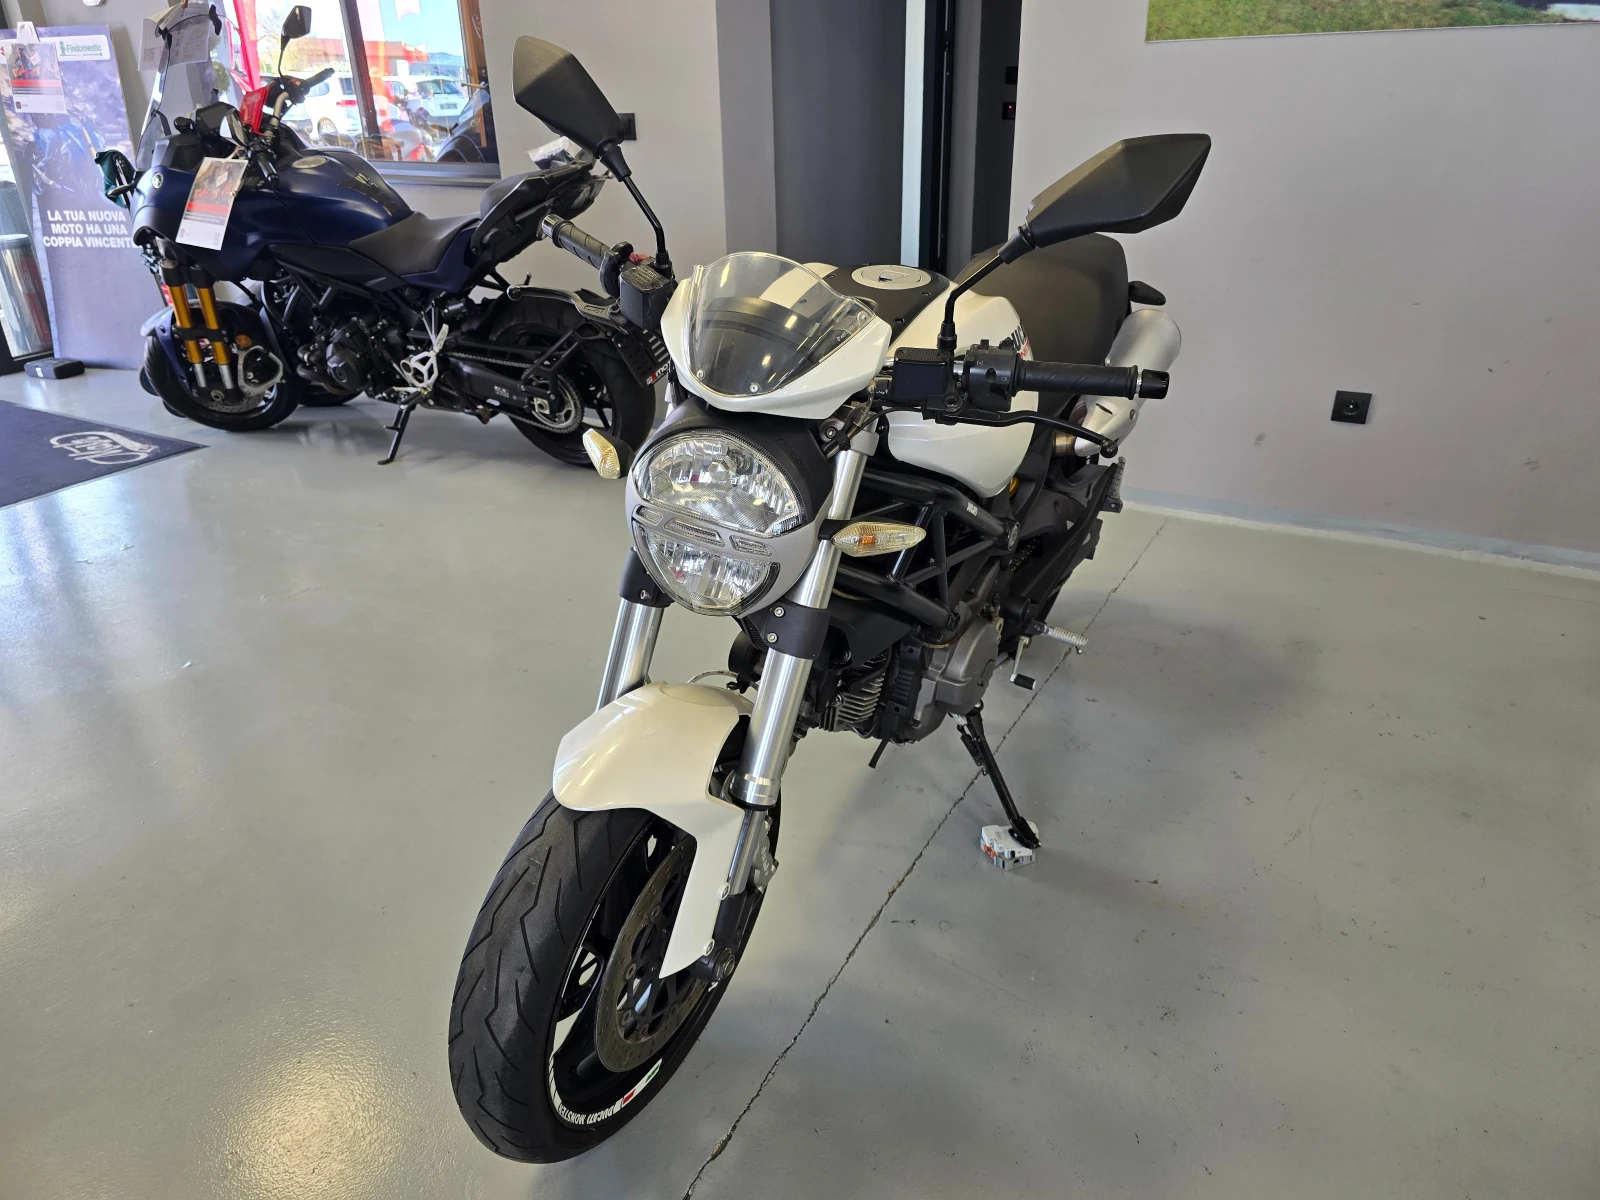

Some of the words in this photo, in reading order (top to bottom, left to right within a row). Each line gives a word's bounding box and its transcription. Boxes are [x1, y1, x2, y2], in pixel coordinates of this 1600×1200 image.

[66, 43, 102, 53] Findomestic
[47, 210, 62, 222] LA
[63, 210, 87, 222] TUA
[87, 210, 127, 222] NUOVA
[50, 223, 84, 235] MOTO
[85, 223, 102, 235] HA
[103, 223, 129, 235] UNA
[43, 236, 84, 248] COPPIA
[557, 1103, 587, 1124] MONSTER
[586, 1105, 615, 1124] DUCATI
